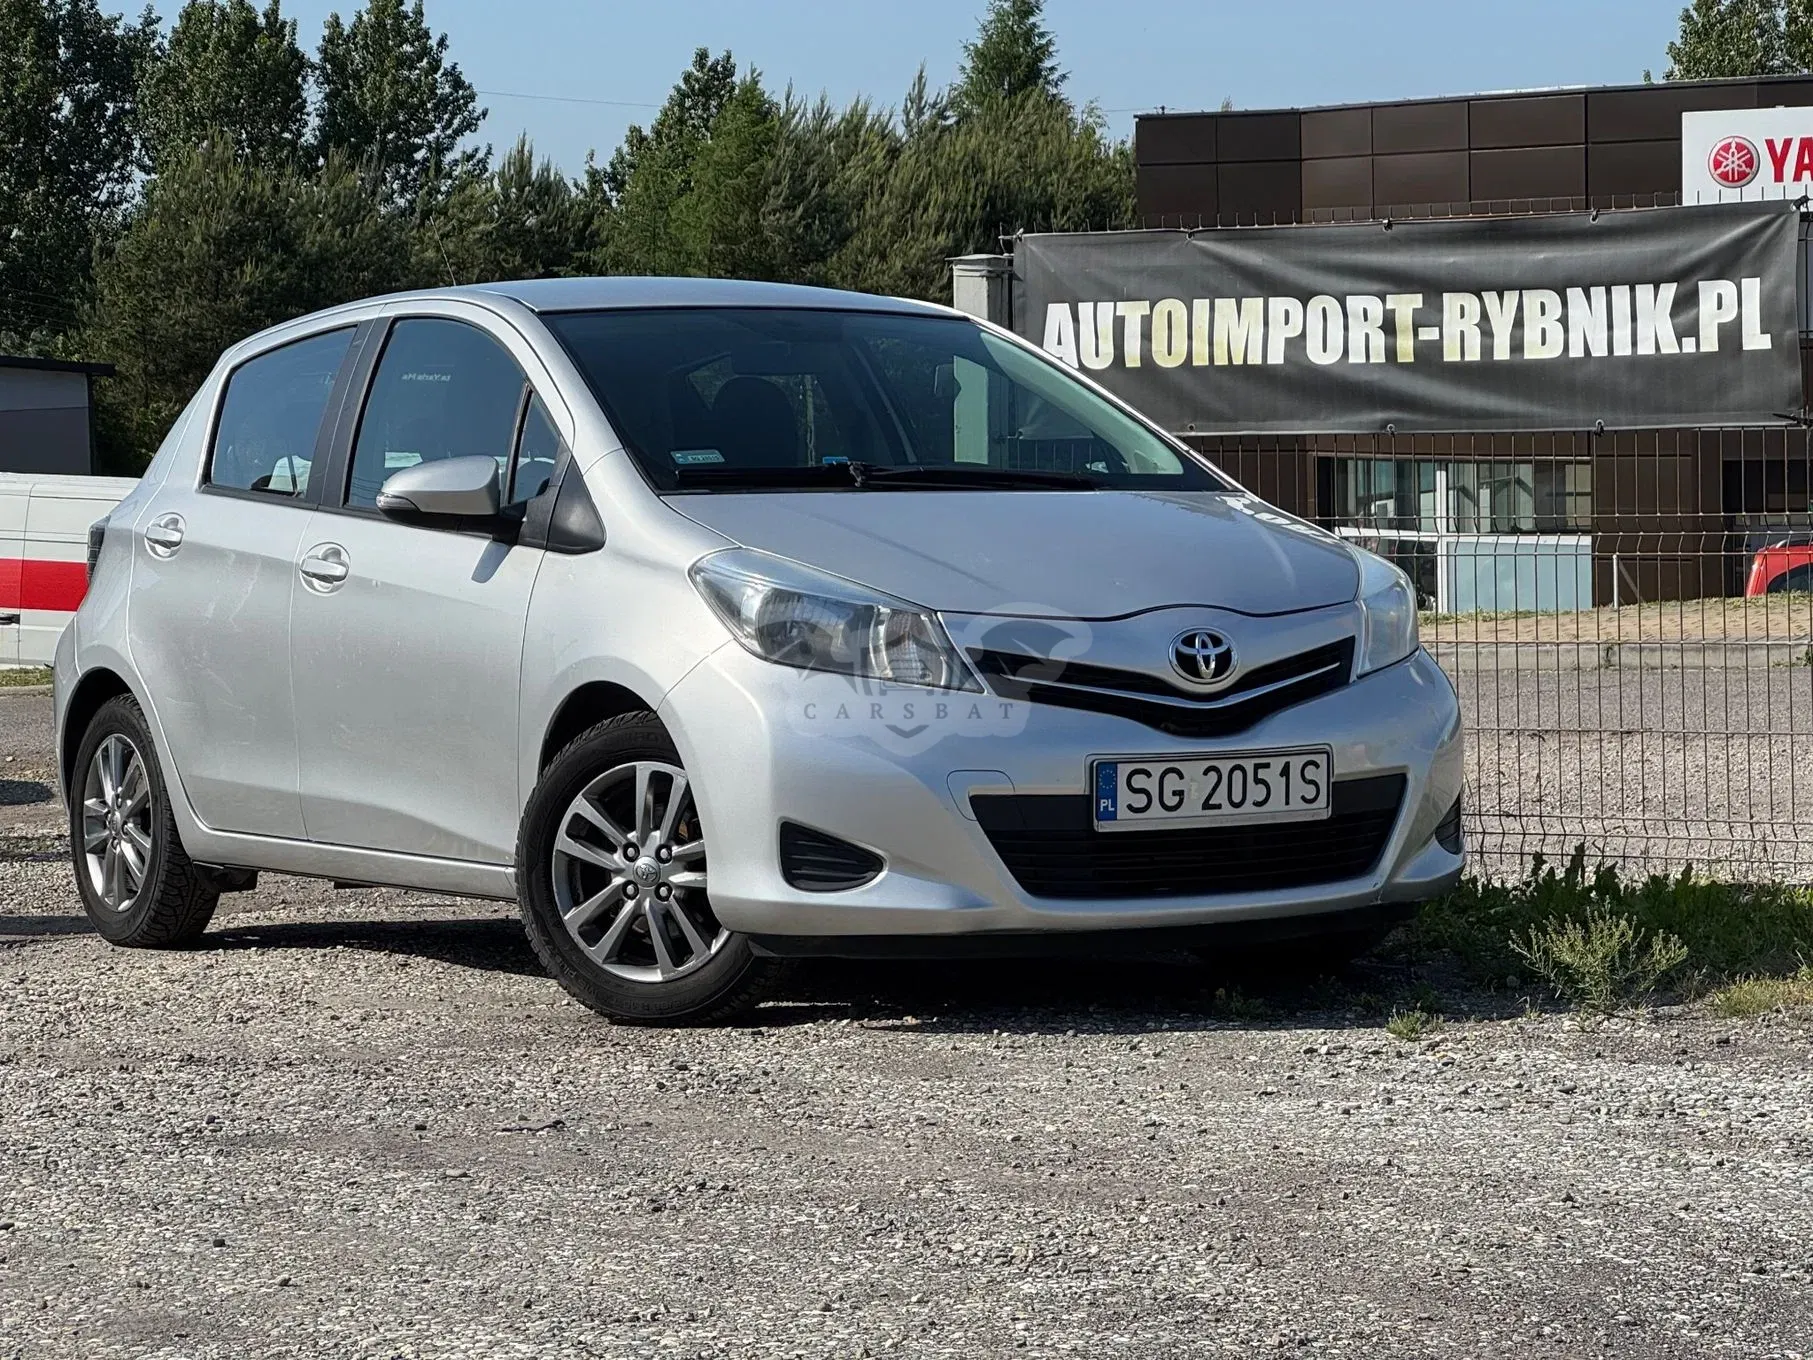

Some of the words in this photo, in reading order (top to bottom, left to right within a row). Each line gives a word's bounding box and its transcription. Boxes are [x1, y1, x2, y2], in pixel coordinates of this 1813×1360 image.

[1764, 137, 1813, 183] YA
[1042, 277, 1772, 370] AUTOIMPORT-RYBNIK.PL
[1100, 799, 1115, 812] PL
[1125, 766, 1185, 814] SG
[1201, 759, 1321, 811] 2051S
